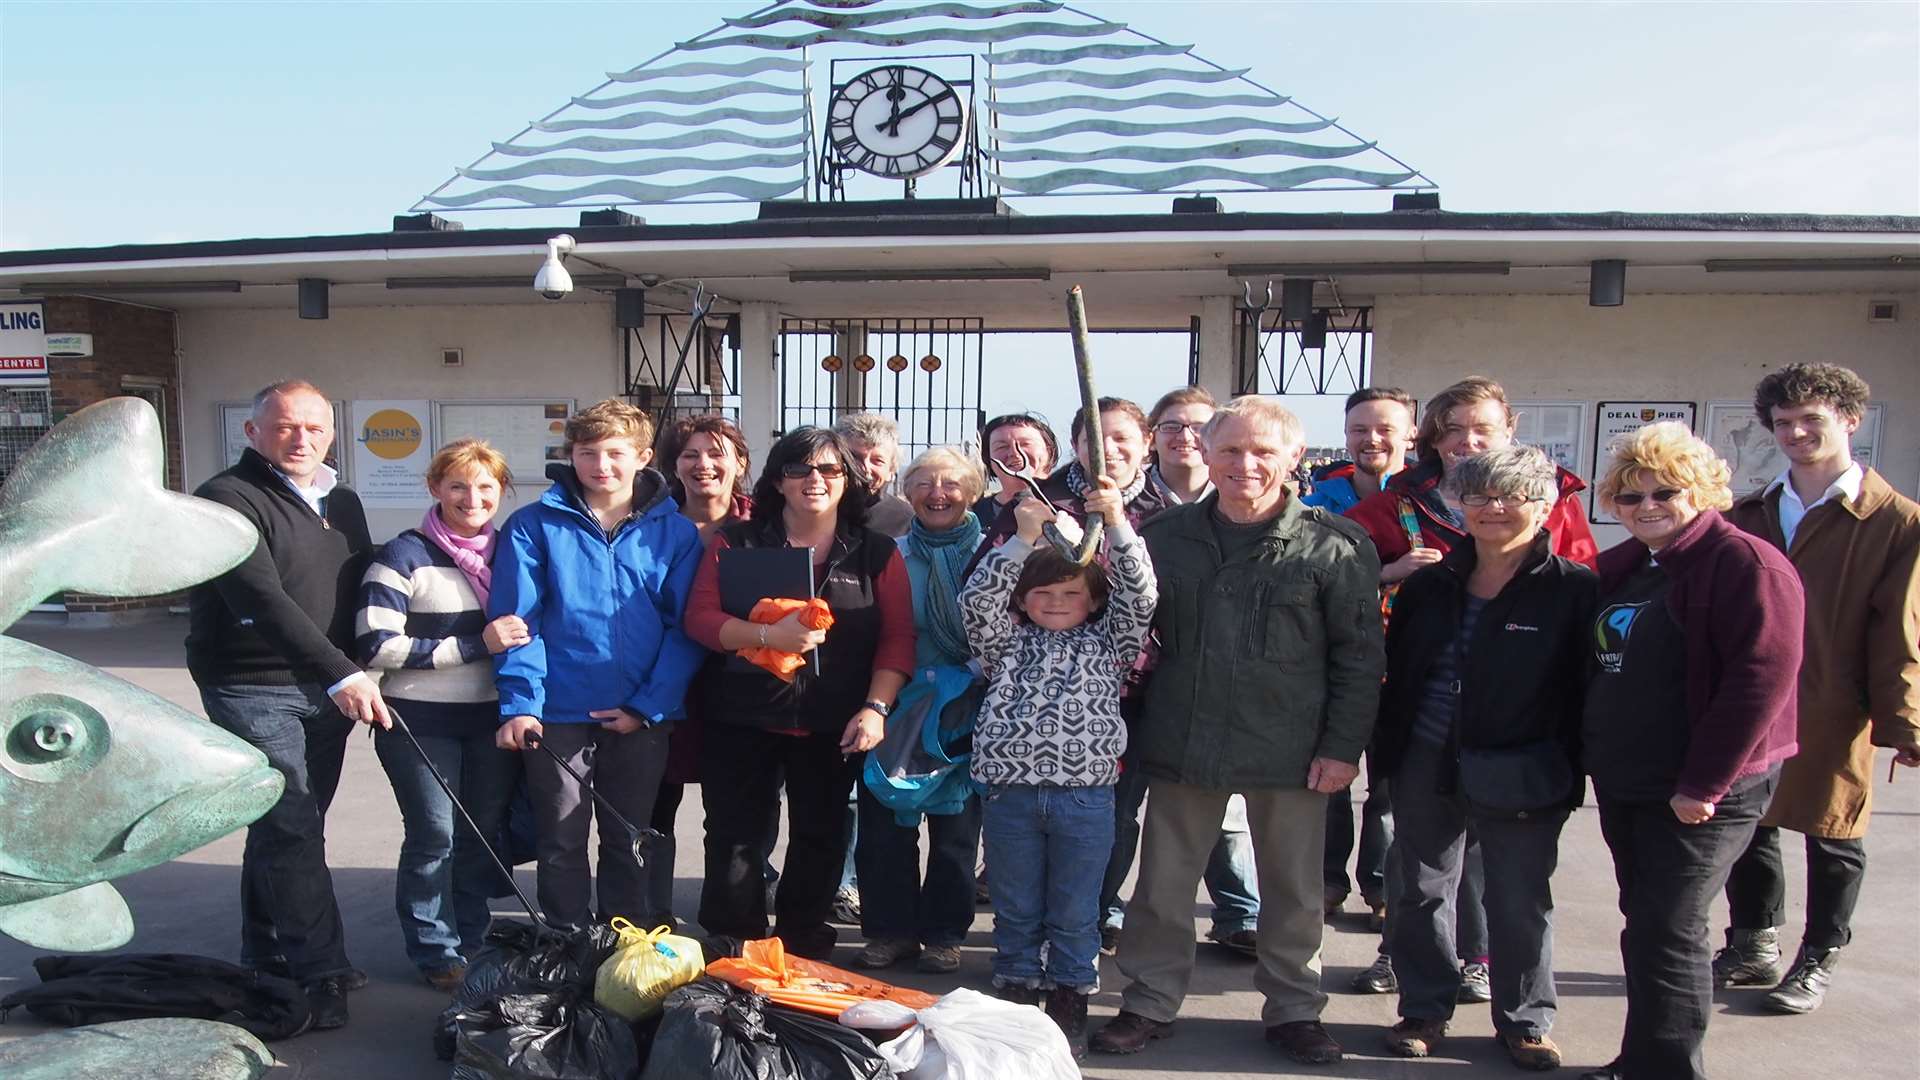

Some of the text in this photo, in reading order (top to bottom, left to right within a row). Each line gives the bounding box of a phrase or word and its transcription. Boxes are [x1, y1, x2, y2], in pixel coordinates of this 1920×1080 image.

[0, 311, 41, 330] LING
[1607, 411, 1685, 419] DEAL PIER
[357, 427, 420, 442] JASIN'S
